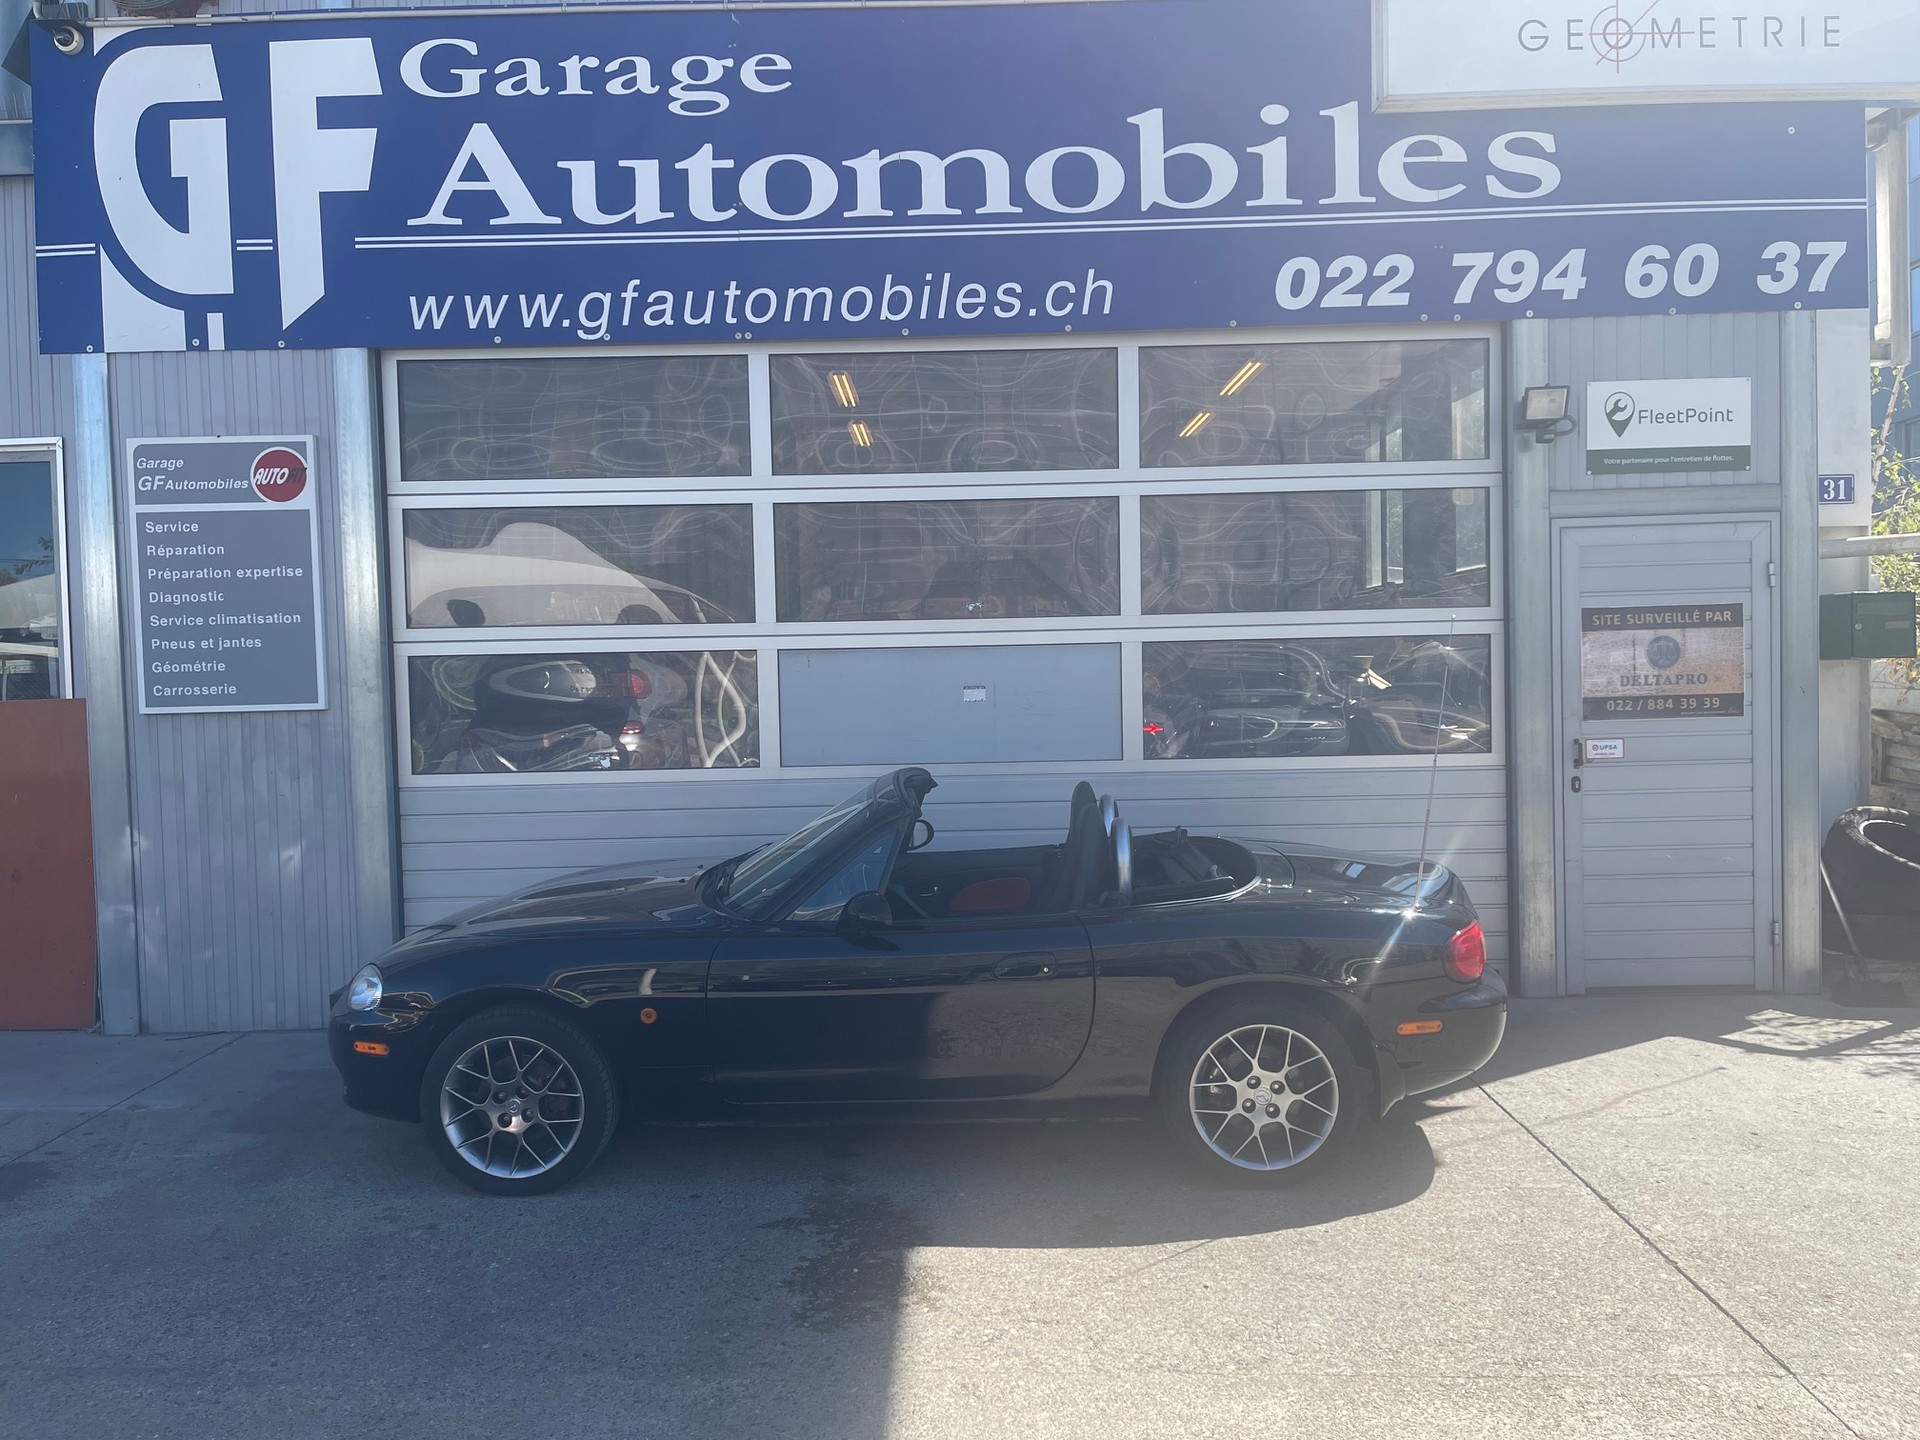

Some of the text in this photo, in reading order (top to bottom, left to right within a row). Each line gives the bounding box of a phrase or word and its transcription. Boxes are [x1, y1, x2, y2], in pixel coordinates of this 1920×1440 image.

[1517, 15, 1841, 52] GEOMETRIE
[400, 37, 793, 117] Garage
[406, 101, 1562, 226] Automobiles
[94, 36, 384, 331] GF
[1275, 240, 1848, 311] 022 794 60 37
[408, 268, 1114, 341] www.gfautomobiles.ch
[1637, 407, 1734, 425] FleetPoint
[136, 457, 184, 471] Garage
[1621, 457, 1654, 465] partenaire
[1654, 457, 1670, 465] pour
[1670, 455, 1703, 463] l'entretien
[1823, 479, 1846, 500] 31
[145, 521, 199, 533] Service
[146, 543, 225, 559] Réparation
[147, 565, 303, 582] Préparation expertise
[149, 590, 225, 605] Diagnostic
[150, 612, 301, 627] Service climatisation
[1592, 609, 1732, 626] SITE SURVEILLÉ PAR
[151, 636, 262, 651] Pneus et jantes
[151, 660, 226, 673] Géométrie
[1619, 672, 1708, 687] DELTAPRO
[153, 683, 237, 697] Carrosserie
[1606, 700, 1633, 711] 022
[1647, 698, 1674, 711] 884
[1680, 697, 1697, 709] 39
[1703, 697, 1720, 708] 39
